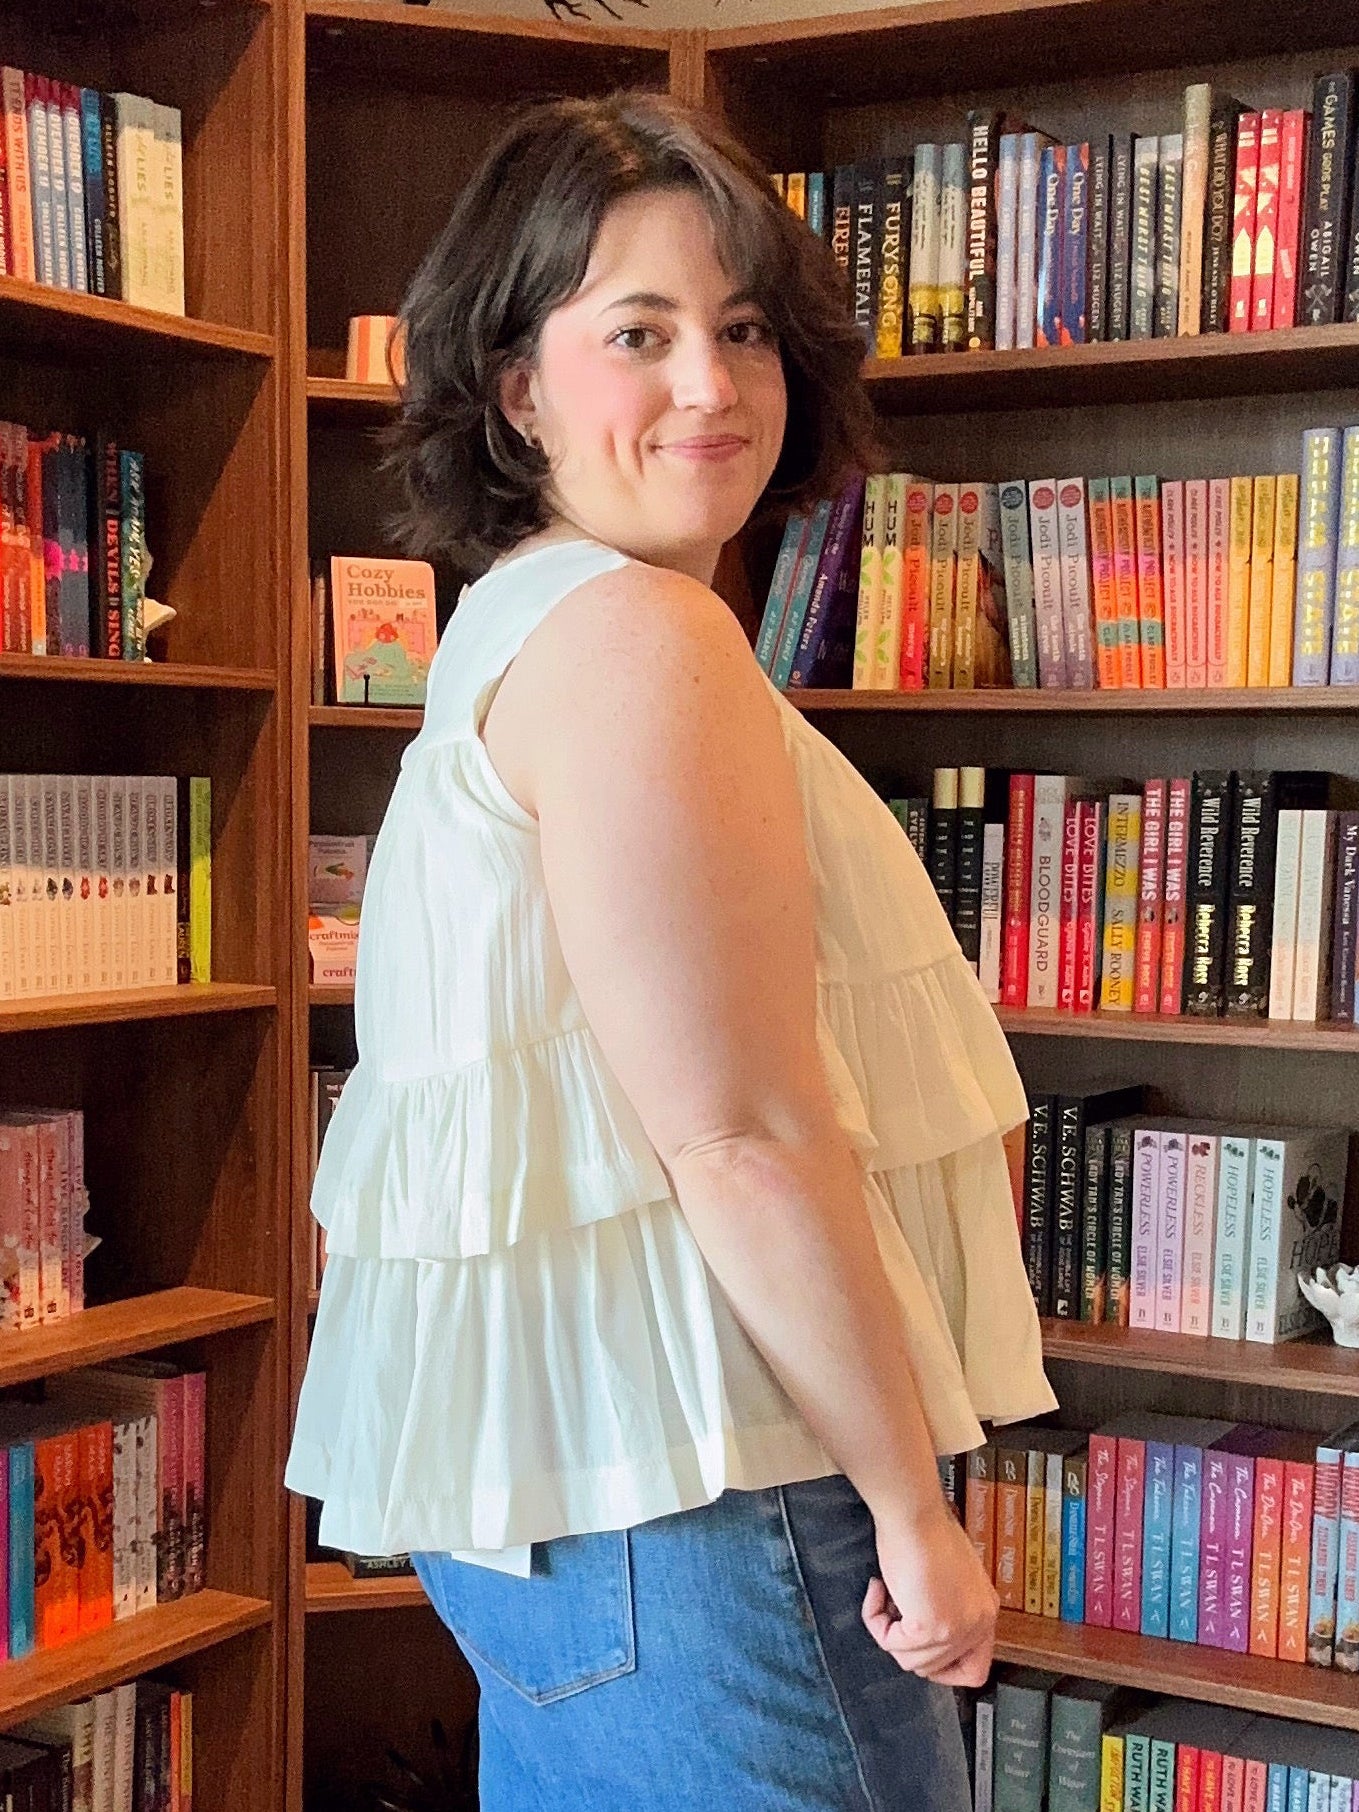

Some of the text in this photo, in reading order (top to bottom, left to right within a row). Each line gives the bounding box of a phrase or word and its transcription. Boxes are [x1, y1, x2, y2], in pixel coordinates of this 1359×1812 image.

[1321, 94, 1339, 149] GAMES
[969, 125, 989, 281] HELLO BEAUTIFUL
[1046, 173, 1060, 206] One
[1072, 172, 1085, 203] One
[1138, 167, 1151, 203] BEST
[1162, 164, 1176, 201] BEST
[1067, 207, 1084, 237] Day
[1093, 210, 1103, 239] WAIT
[1111, 155, 1127, 331] LYING IN WAIT LIZ NUGENT
[1136, 206, 1150, 254] WORST
[1162, 203, 1174, 250] WORST
[881, 201, 901, 328] FURYSONG
[1308, 227, 1321, 273] OWEN
[1320, 220, 1333, 277] ABIGAIL
[1092, 263, 1102, 280] LIZ
[1160, 254, 1173, 297] THING
[1090, 284, 1101, 331] NUGENT
[962, 518, 974, 550] Jodi
[346, 564, 395, 583] Cozy
[1006, 515, 1024, 609] Jodi Picoult
[1039, 515, 1055, 610] Jodi Picoult
[1064, 513, 1080, 608] Jodi Picoult
[106, 519, 120, 657] DEVILS SING
[348, 582, 426, 599] Hobbies
[907, 558, 921, 612] Picoult
[935, 559, 949, 613] Picoult
[961, 557, 975, 612] Picoult
[1146, 788, 1161, 816] THE
[1170, 788, 1185, 816] THE
[1083, 818, 1096, 856] LOVE
[1144, 820, 1160, 855] GIRL
[1168, 821, 1184, 855] GIRL
[1342, 824, 1358, 842] My
[1063, 818, 1077, 904] LOVE BITES
[1082, 863, 1096, 904] BITES
[1344, 846, 1358, 876] Dark
[983, 862, 1000, 921] POWERFUL
[1108, 802, 1130, 1006] INTERMEZZO SALLY ROONEY
[1141, 867, 1158, 901] WAS
[1165, 867, 1181, 901] WAS
[1193, 798, 1220, 985] Wild Reverence Rebecca Ross
[1233, 798, 1261, 986] Wild Reverence Rebecca Ross
[1342, 880, 1355, 925] Vanessa
[1036, 855, 1051, 972] BLOODGUARD
[322, 966, 357, 977] craft
[1029, 1143, 1047, 1228] SCHWAB
[1059, 1146, 1077, 1230] SCHWAB
[1087, 1159, 1099, 1183] LADY
[1114, 1159, 1126, 1183] LADY
[1192, 1164, 1208, 1237] RECKLESS
[1086, 1215, 1098, 1247] CIRCLE
[1111, 1216, 1124, 1248] CIRCLE
[1135, 1152, 1153, 1297] POWERLESS ELSIE SILVER
[1161, 1155, 1179, 1301] POWERLESS ELSIE SILVER
[1220, 1164, 1240, 1306] HOPELESS ELSIE SILVER
[1255, 1167, 1275, 1310] HOPELESS ELSIE SILVER
[1086, 1250, 1097, 1262] OF
[1111, 1251, 1123, 1264] OF
[1085, 1265, 1098, 1300] WOMEN
[1110, 1266, 1123, 1301] WOMEN
[1235, 1466, 1248, 1485] The
[1262, 1472, 1276, 1491] The
[1291, 1478, 1306, 1496] The
[1093, 1551, 1106, 1596] SWAN
[1120, 1555, 1134, 1601] SWAN
[1150, 1559, 1164, 1603] SWAN
[1179, 1564, 1193, 1610] SWAN
[1204, 1568, 1219, 1615] SWAN
[1229, 1573, 1244, 1619] SWAN
[1256, 1577, 1272, 1622] SWAN
[1285, 1584, 1300, 1629] SWAN
[1130, 1742, 1144, 1812] RUTH WA
[1155, 1748, 1168, 1789] RUTH
